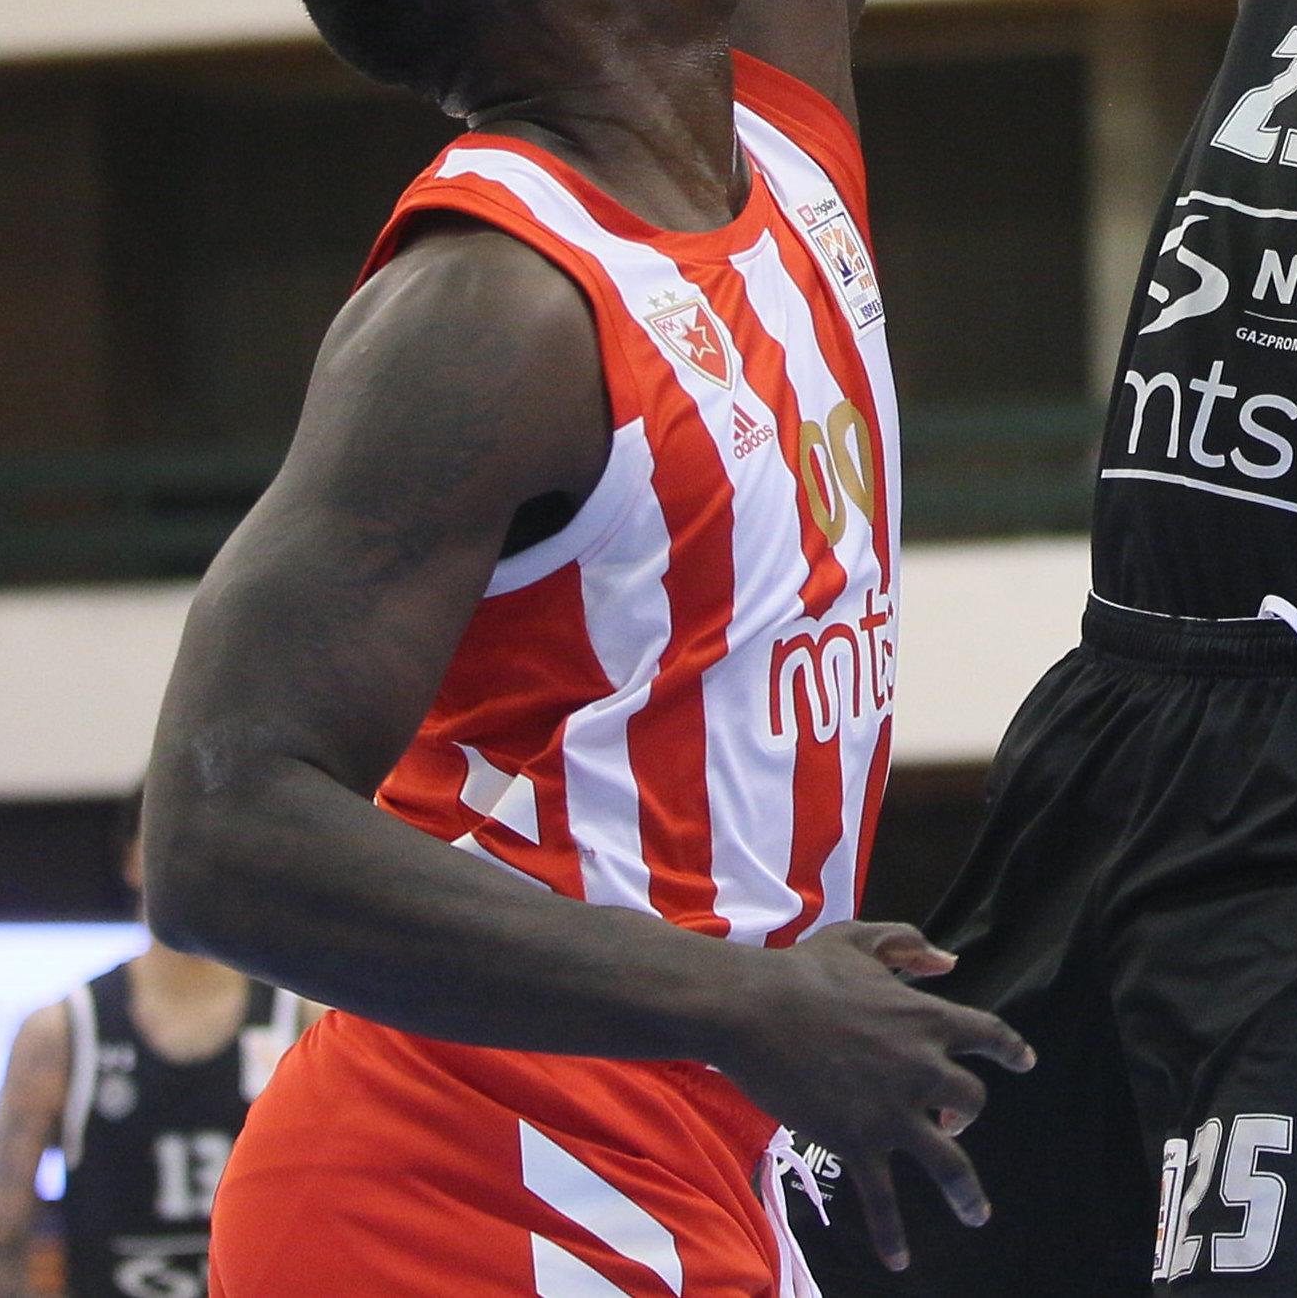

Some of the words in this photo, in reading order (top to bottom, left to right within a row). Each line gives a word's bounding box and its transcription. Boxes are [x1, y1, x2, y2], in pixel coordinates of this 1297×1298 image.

[733, 424, 774, 460] adidas
[798, 398, 875, 547] 00
[802, 1142, 843, 1179] NIS
[1166, 1113, 1294, 1284] 25
